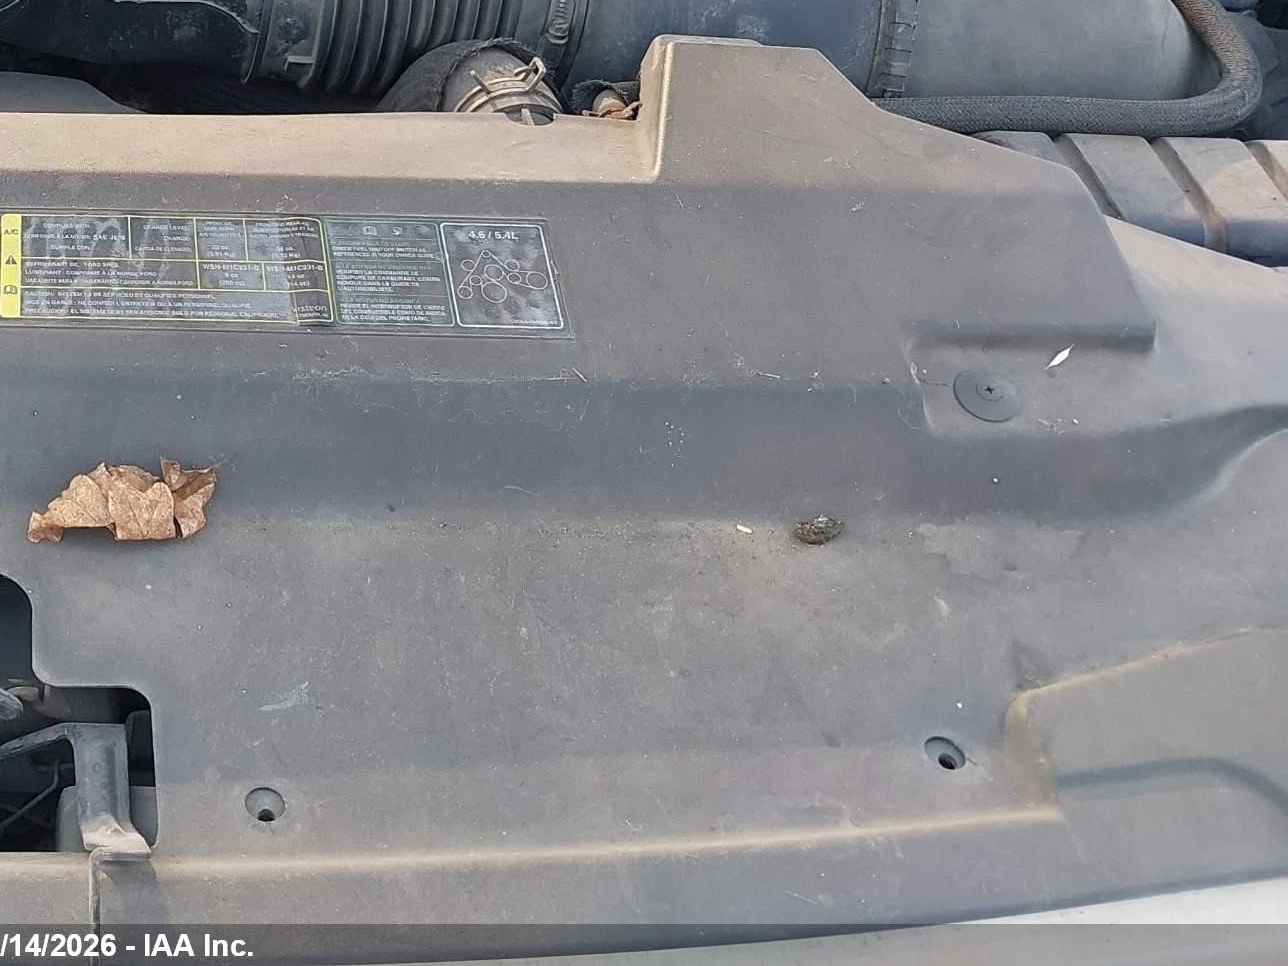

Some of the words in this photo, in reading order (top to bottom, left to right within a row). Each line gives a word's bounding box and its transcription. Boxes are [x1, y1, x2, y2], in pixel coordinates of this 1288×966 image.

[3, 228, 19, 236] A/C
[467, 230, 486, 240] 4.6
[494, 230, 520, 241] 5.4L
